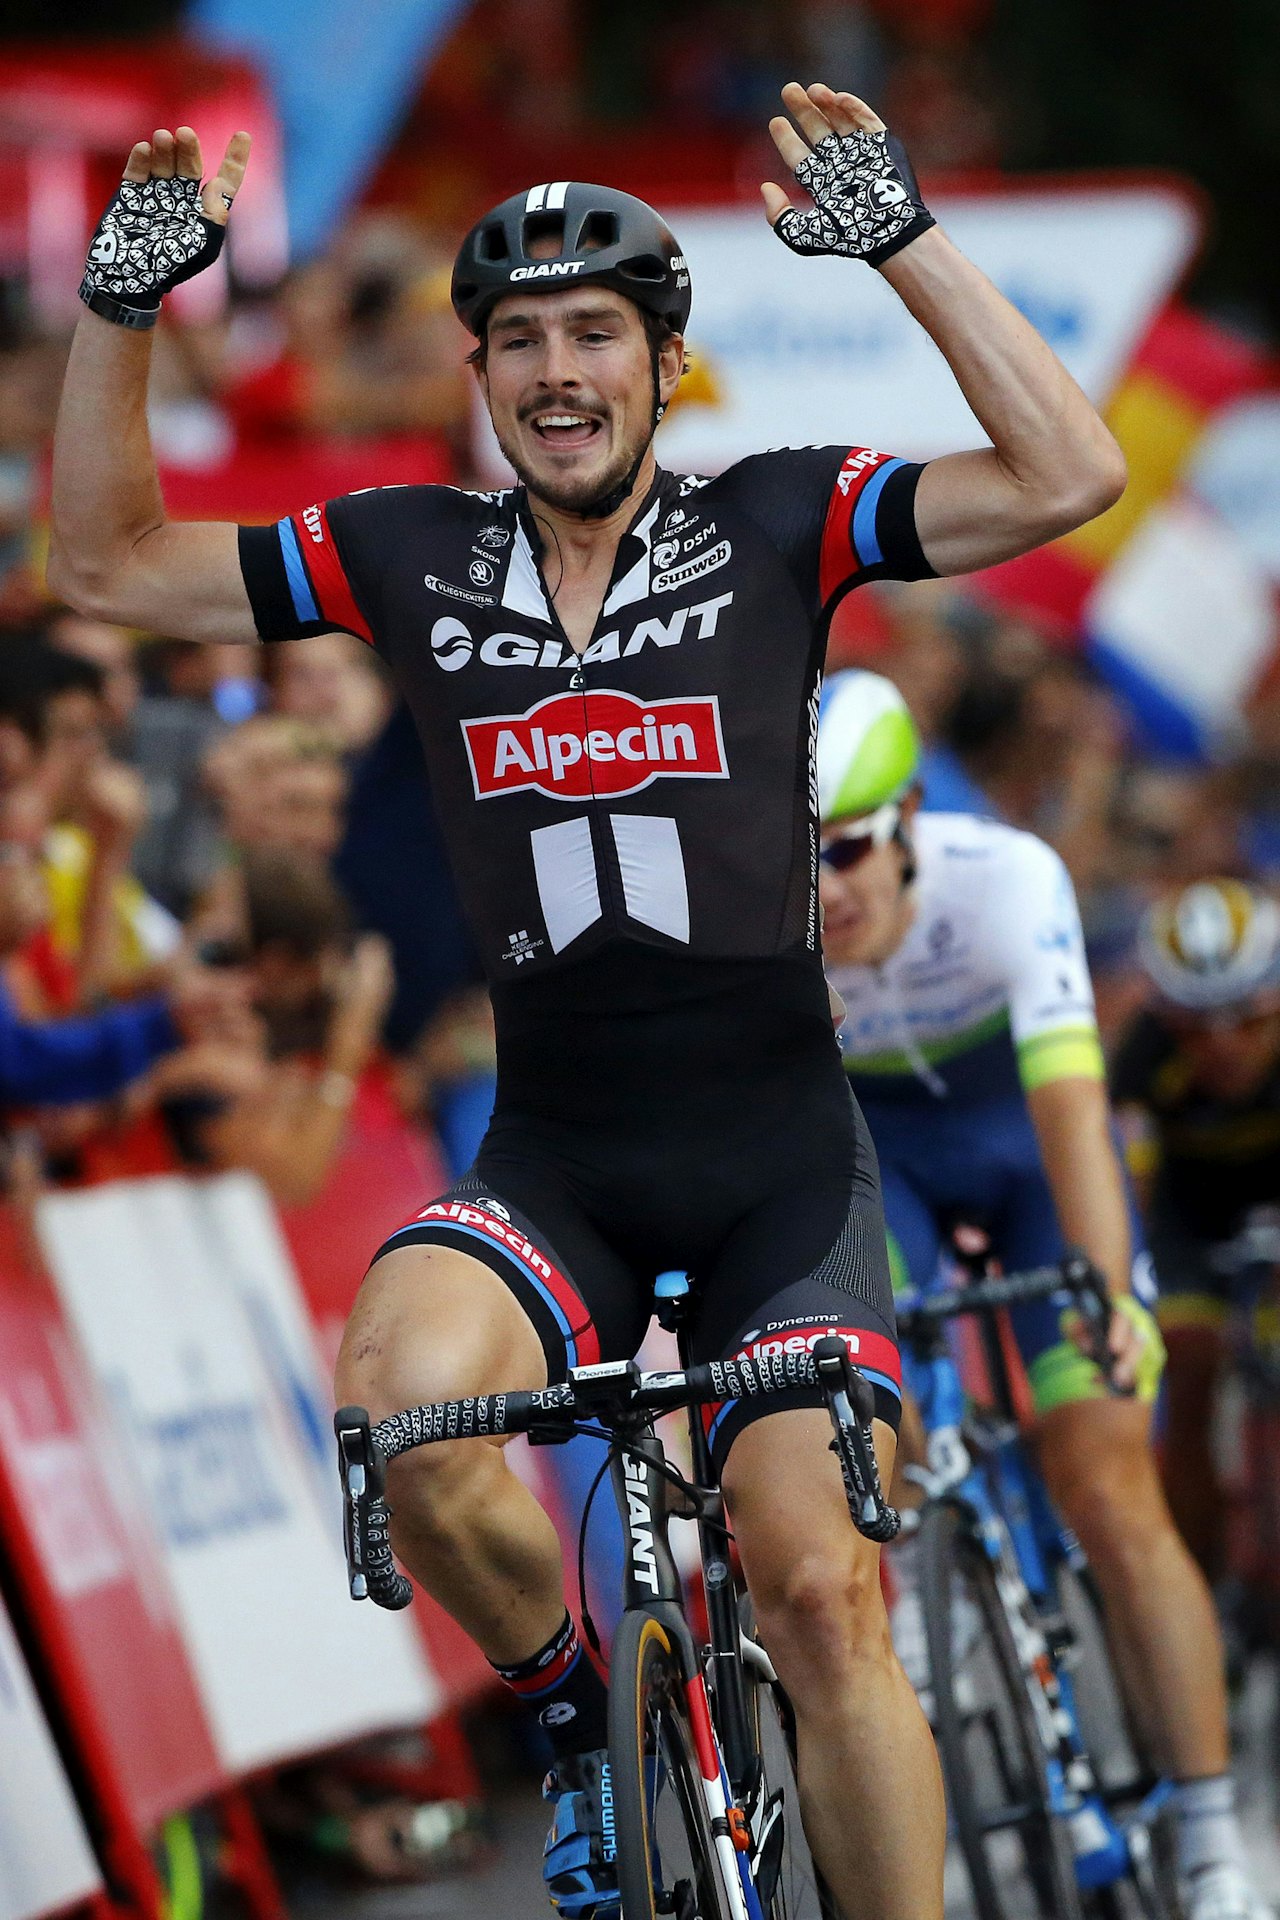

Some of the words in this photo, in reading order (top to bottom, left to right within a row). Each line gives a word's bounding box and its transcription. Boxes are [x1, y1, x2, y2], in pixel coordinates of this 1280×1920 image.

[510, 261, 585, 281] GIANT
[654, 515, 699, 543] XEONDO
[683, 522, 716, 552] DSM
[658, 547, 727, 589] Sunweb
[480, 590, 734, 669] GIANT
[493, 714, 699, 781] Alpecin
[417, 1204, 552, 1279] Alpecin
[577, 1366, 625, 1379] Pioneer
[622, 1453, 659, 1595] GIANT
